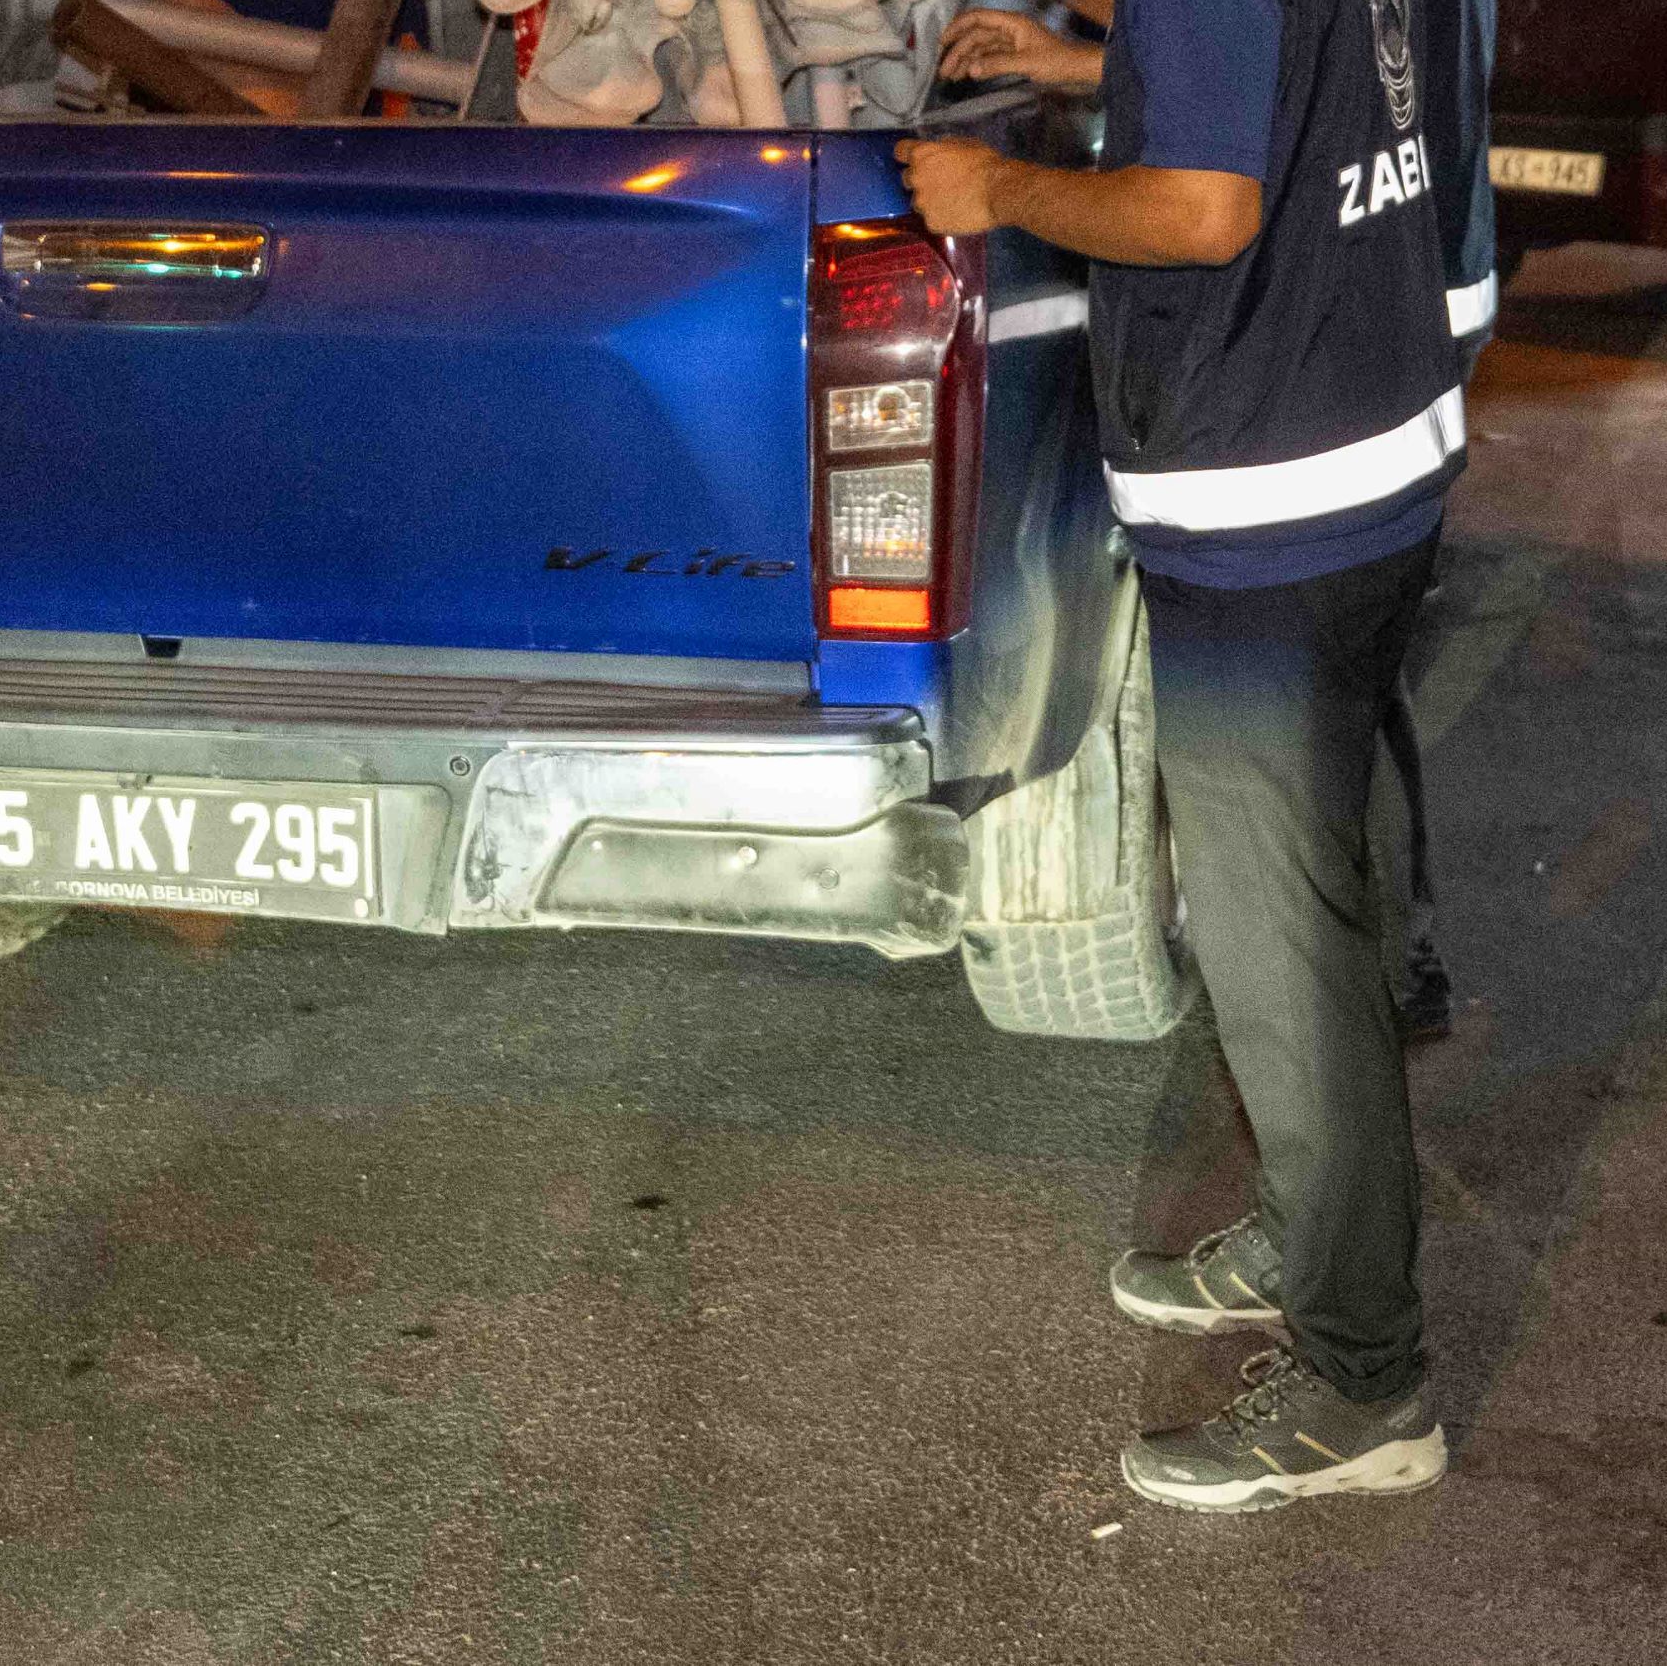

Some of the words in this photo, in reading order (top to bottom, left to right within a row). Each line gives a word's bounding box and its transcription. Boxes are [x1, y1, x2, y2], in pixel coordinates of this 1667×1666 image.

[74, 793, 198, 874] AKY
[229, 802, 361, 889] 295
[152, 884, 260, 907] BELEDİYESİ
